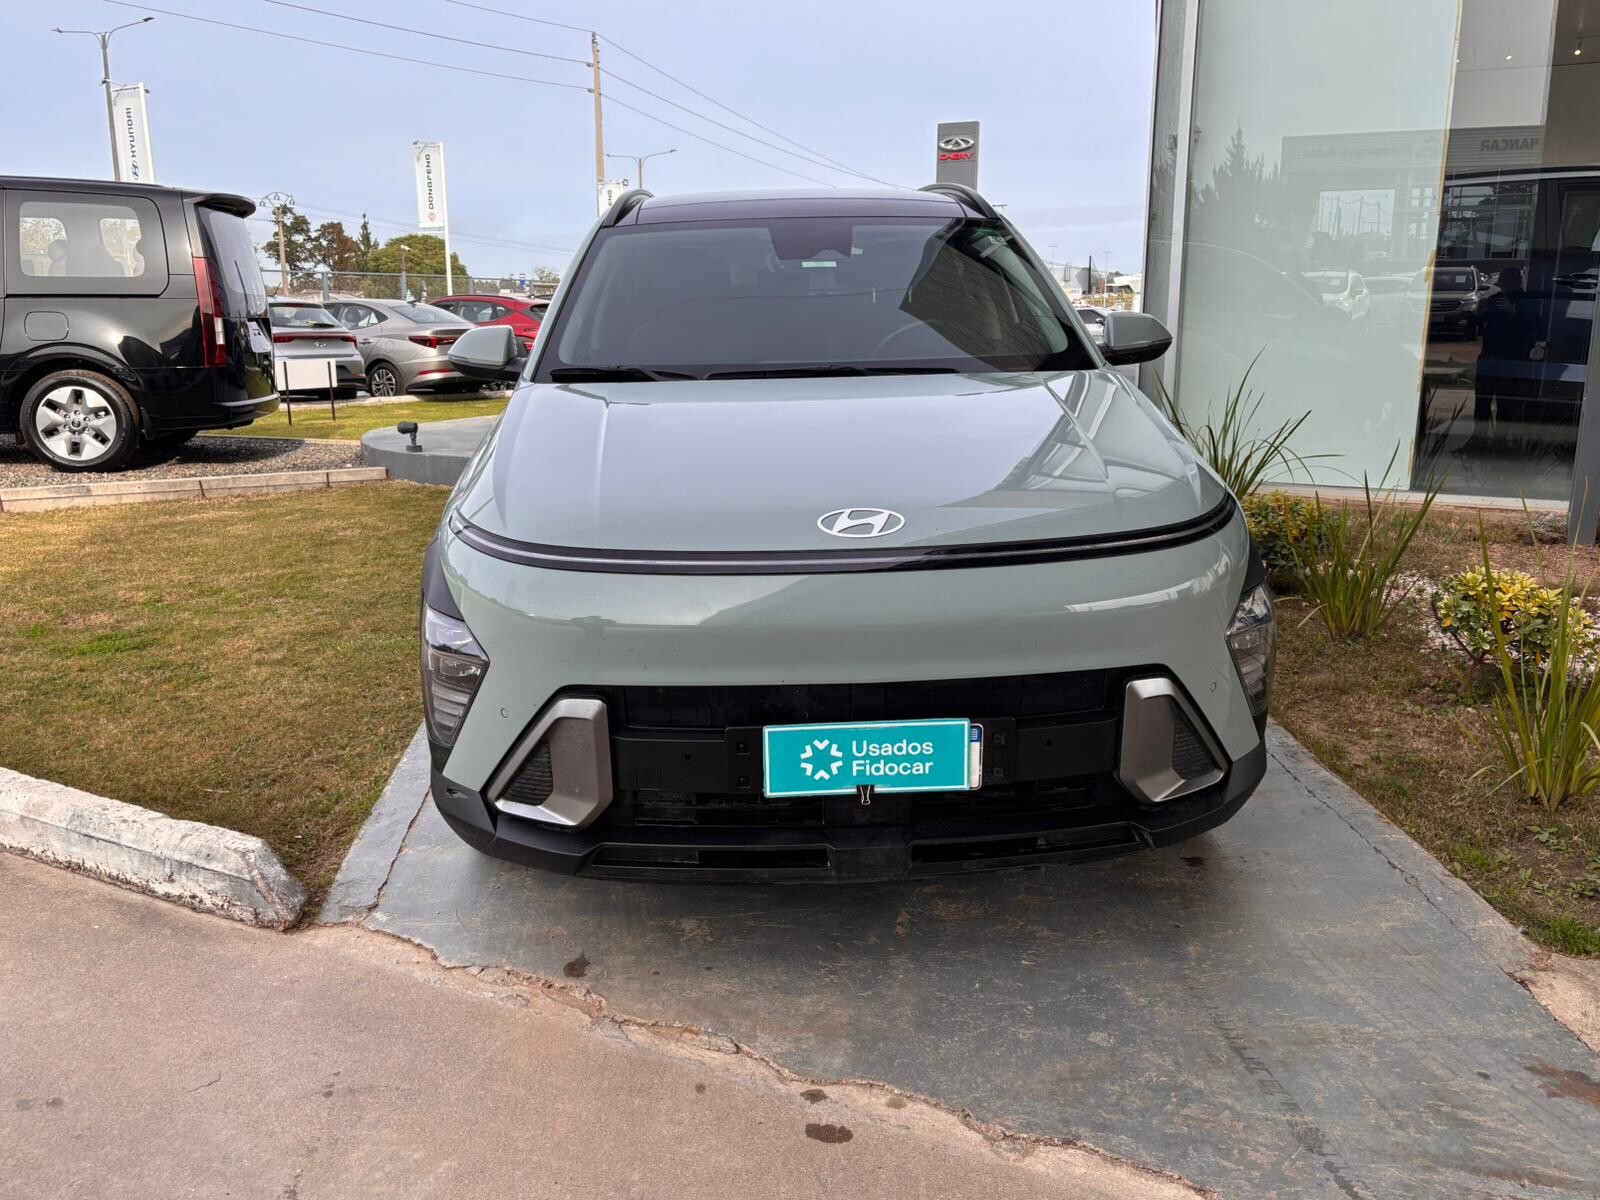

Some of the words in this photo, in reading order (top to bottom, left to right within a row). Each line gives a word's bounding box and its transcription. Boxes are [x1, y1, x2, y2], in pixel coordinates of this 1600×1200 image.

[126, 107, 137, 158] HYUNDAI
[939, 151, 975, 161] CHERY
[425, 153, 434, 210] DONGFENG
[852, 738, 934, 757] Usados
[852, 759, 934, 777] Fidocar
